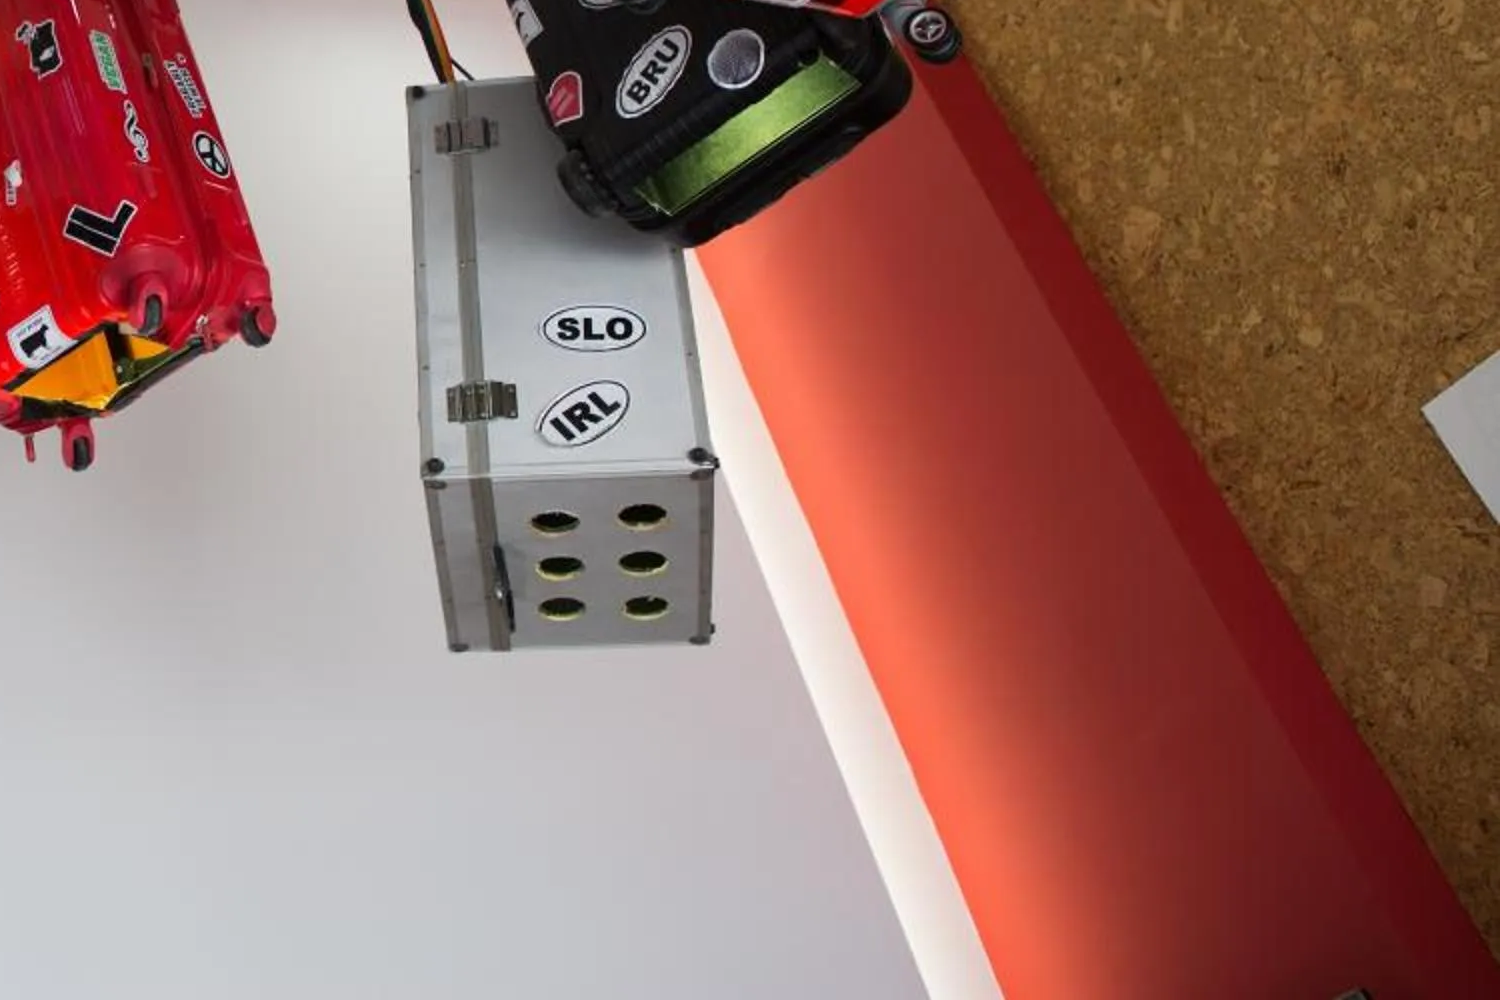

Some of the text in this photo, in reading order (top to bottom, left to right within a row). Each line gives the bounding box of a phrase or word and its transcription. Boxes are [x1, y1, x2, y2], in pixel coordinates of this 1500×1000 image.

[629, 37, 680, 103] BRU
[556, 318, 632, 342] SLO
[549, 389, 620, 441] IRL
